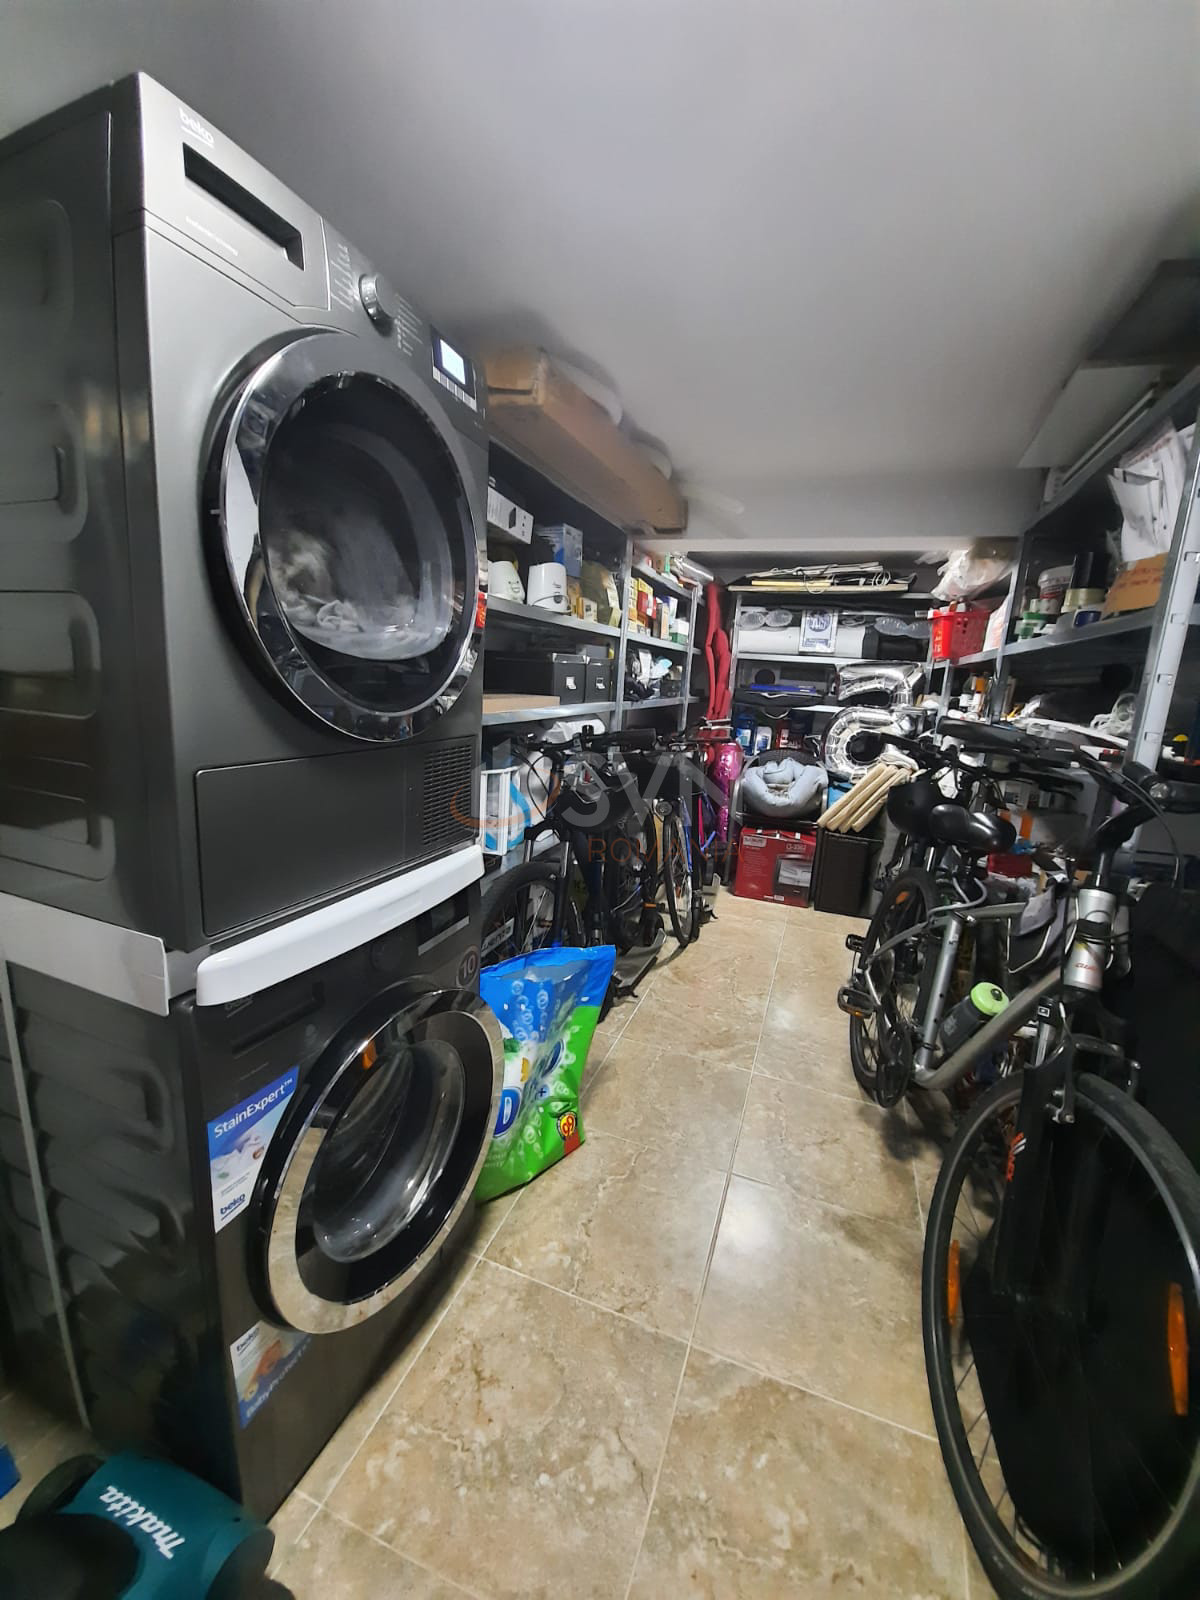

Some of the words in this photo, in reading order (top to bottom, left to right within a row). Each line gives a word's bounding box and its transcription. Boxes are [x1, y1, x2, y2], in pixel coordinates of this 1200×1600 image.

[179, 107, 214, 144] beko
[461, 956, 475, 979] 10
[220, 1193, 246, 1216] beko
